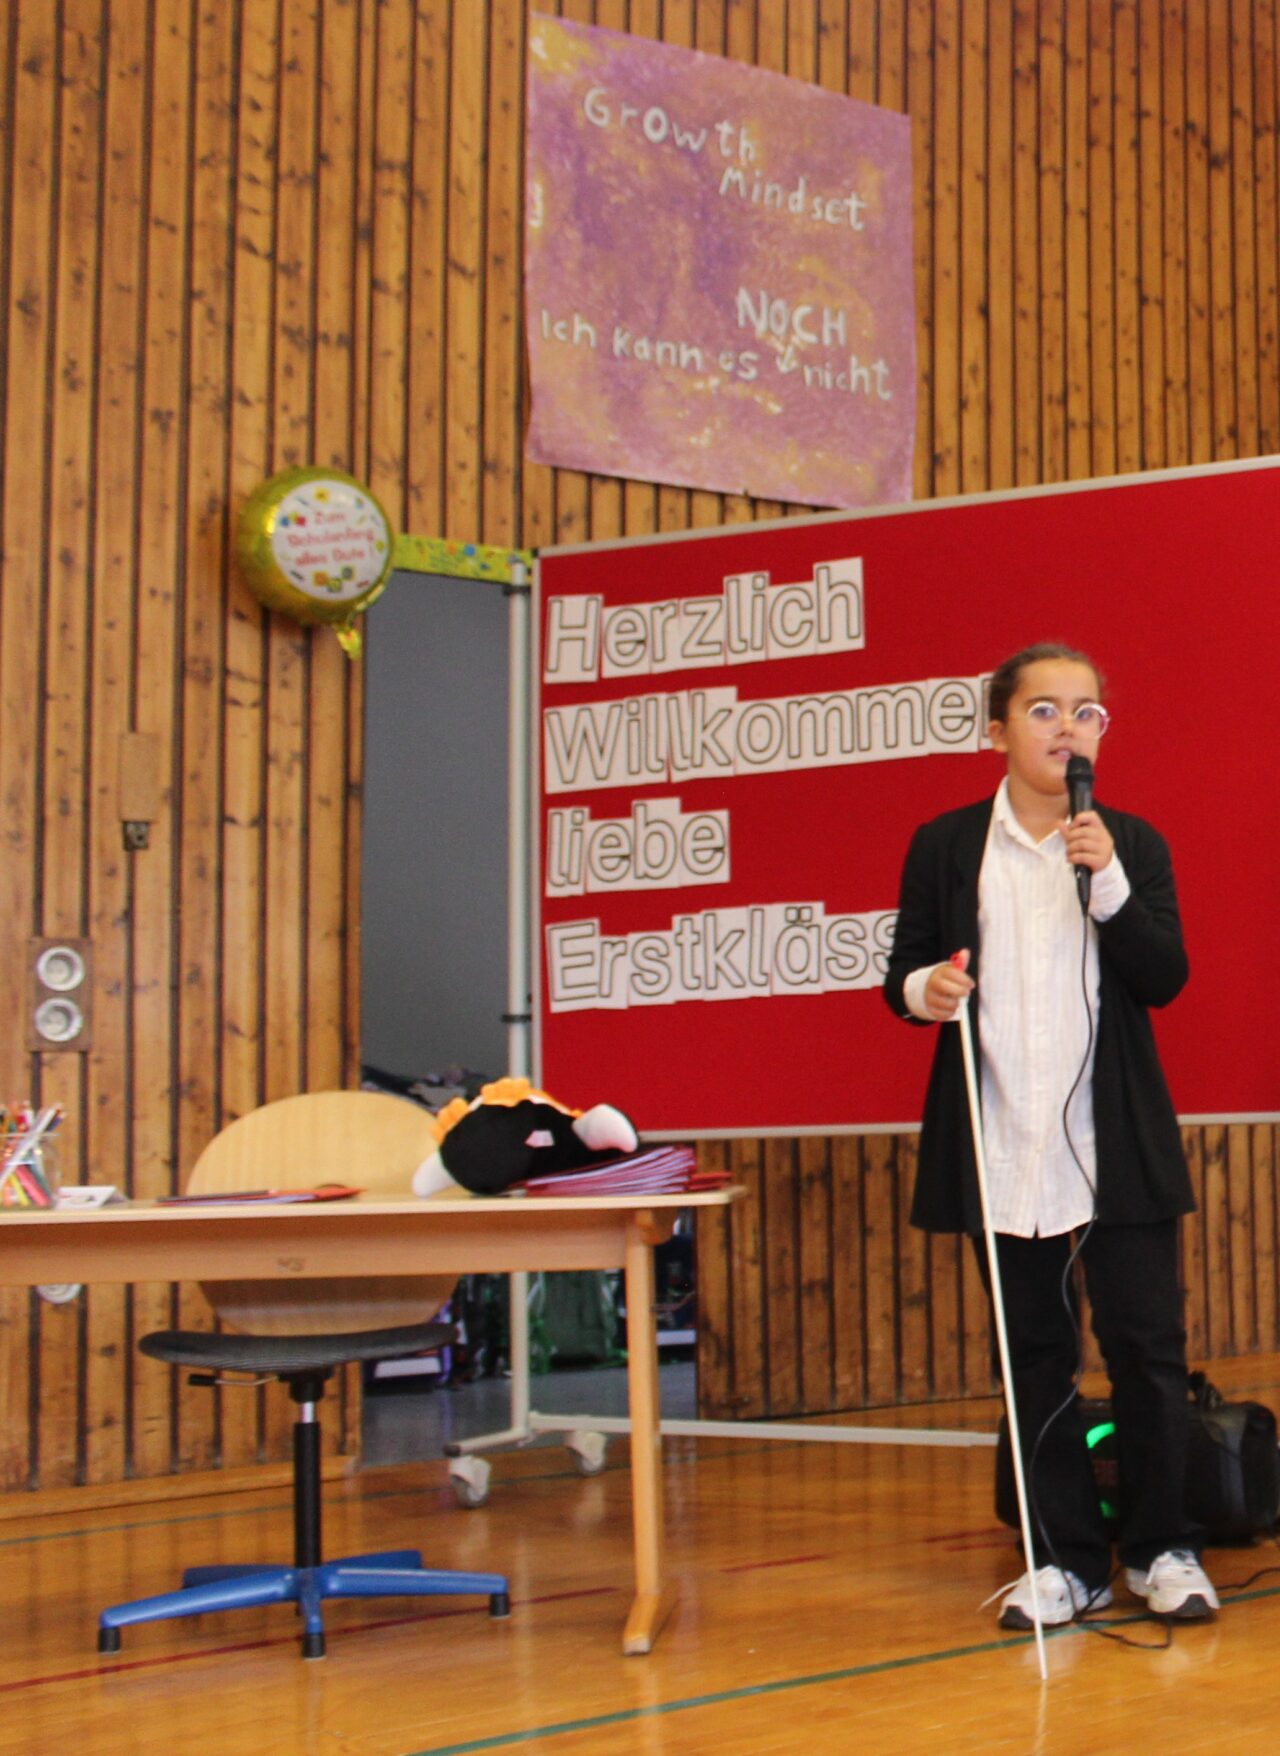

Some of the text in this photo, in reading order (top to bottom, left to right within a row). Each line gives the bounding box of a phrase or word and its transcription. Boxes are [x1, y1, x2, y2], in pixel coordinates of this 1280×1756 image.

[719, 167, 867, 231] Mindset
[541, 310, 597, 348] Ich
[718, 349, 760, 381] es
[803, 354, 893, 400] nicht
[736, 287, 848, 346] NOCH
[545, 565, 864, 674] Herzlich
[545, 678, 991, 785] Willkomme
[548, 803, 727, 888] liebe
